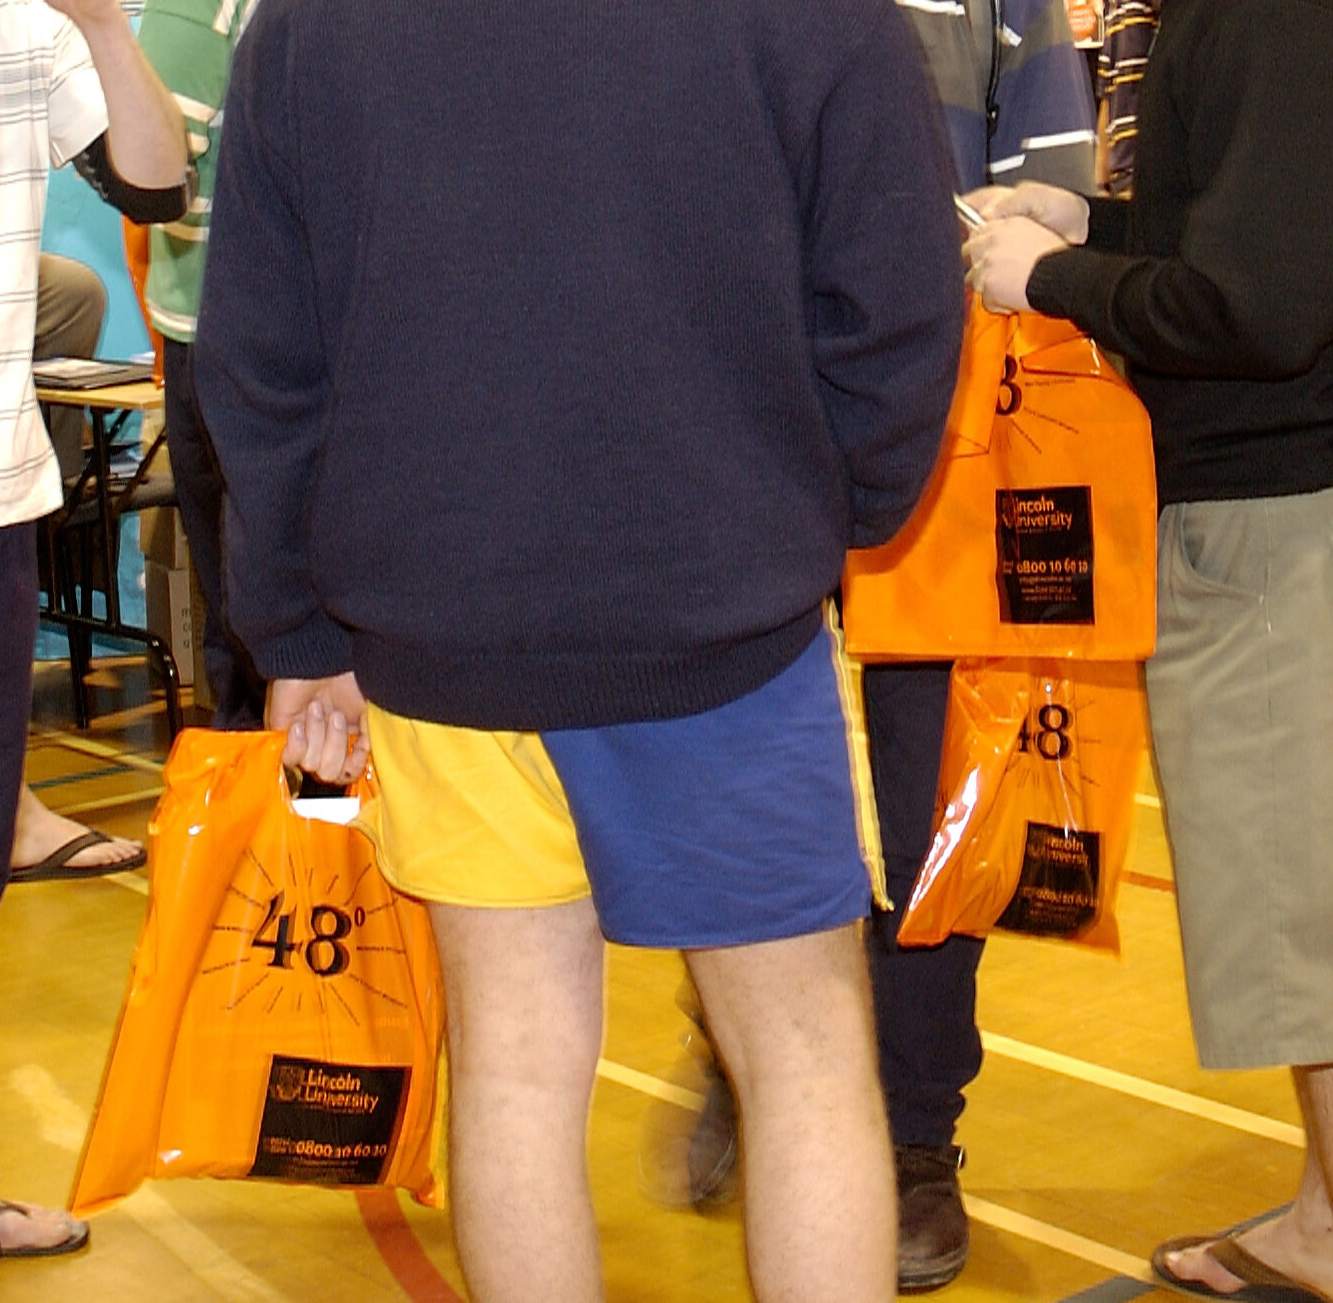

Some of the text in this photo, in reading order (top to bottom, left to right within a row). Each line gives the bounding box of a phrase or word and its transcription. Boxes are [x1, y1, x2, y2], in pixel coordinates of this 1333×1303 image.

[307, 1067, 362, 1092] Lincoln
[304, 1084, 379, 1114] University
[296, 1138, 333, 1158] 0800
